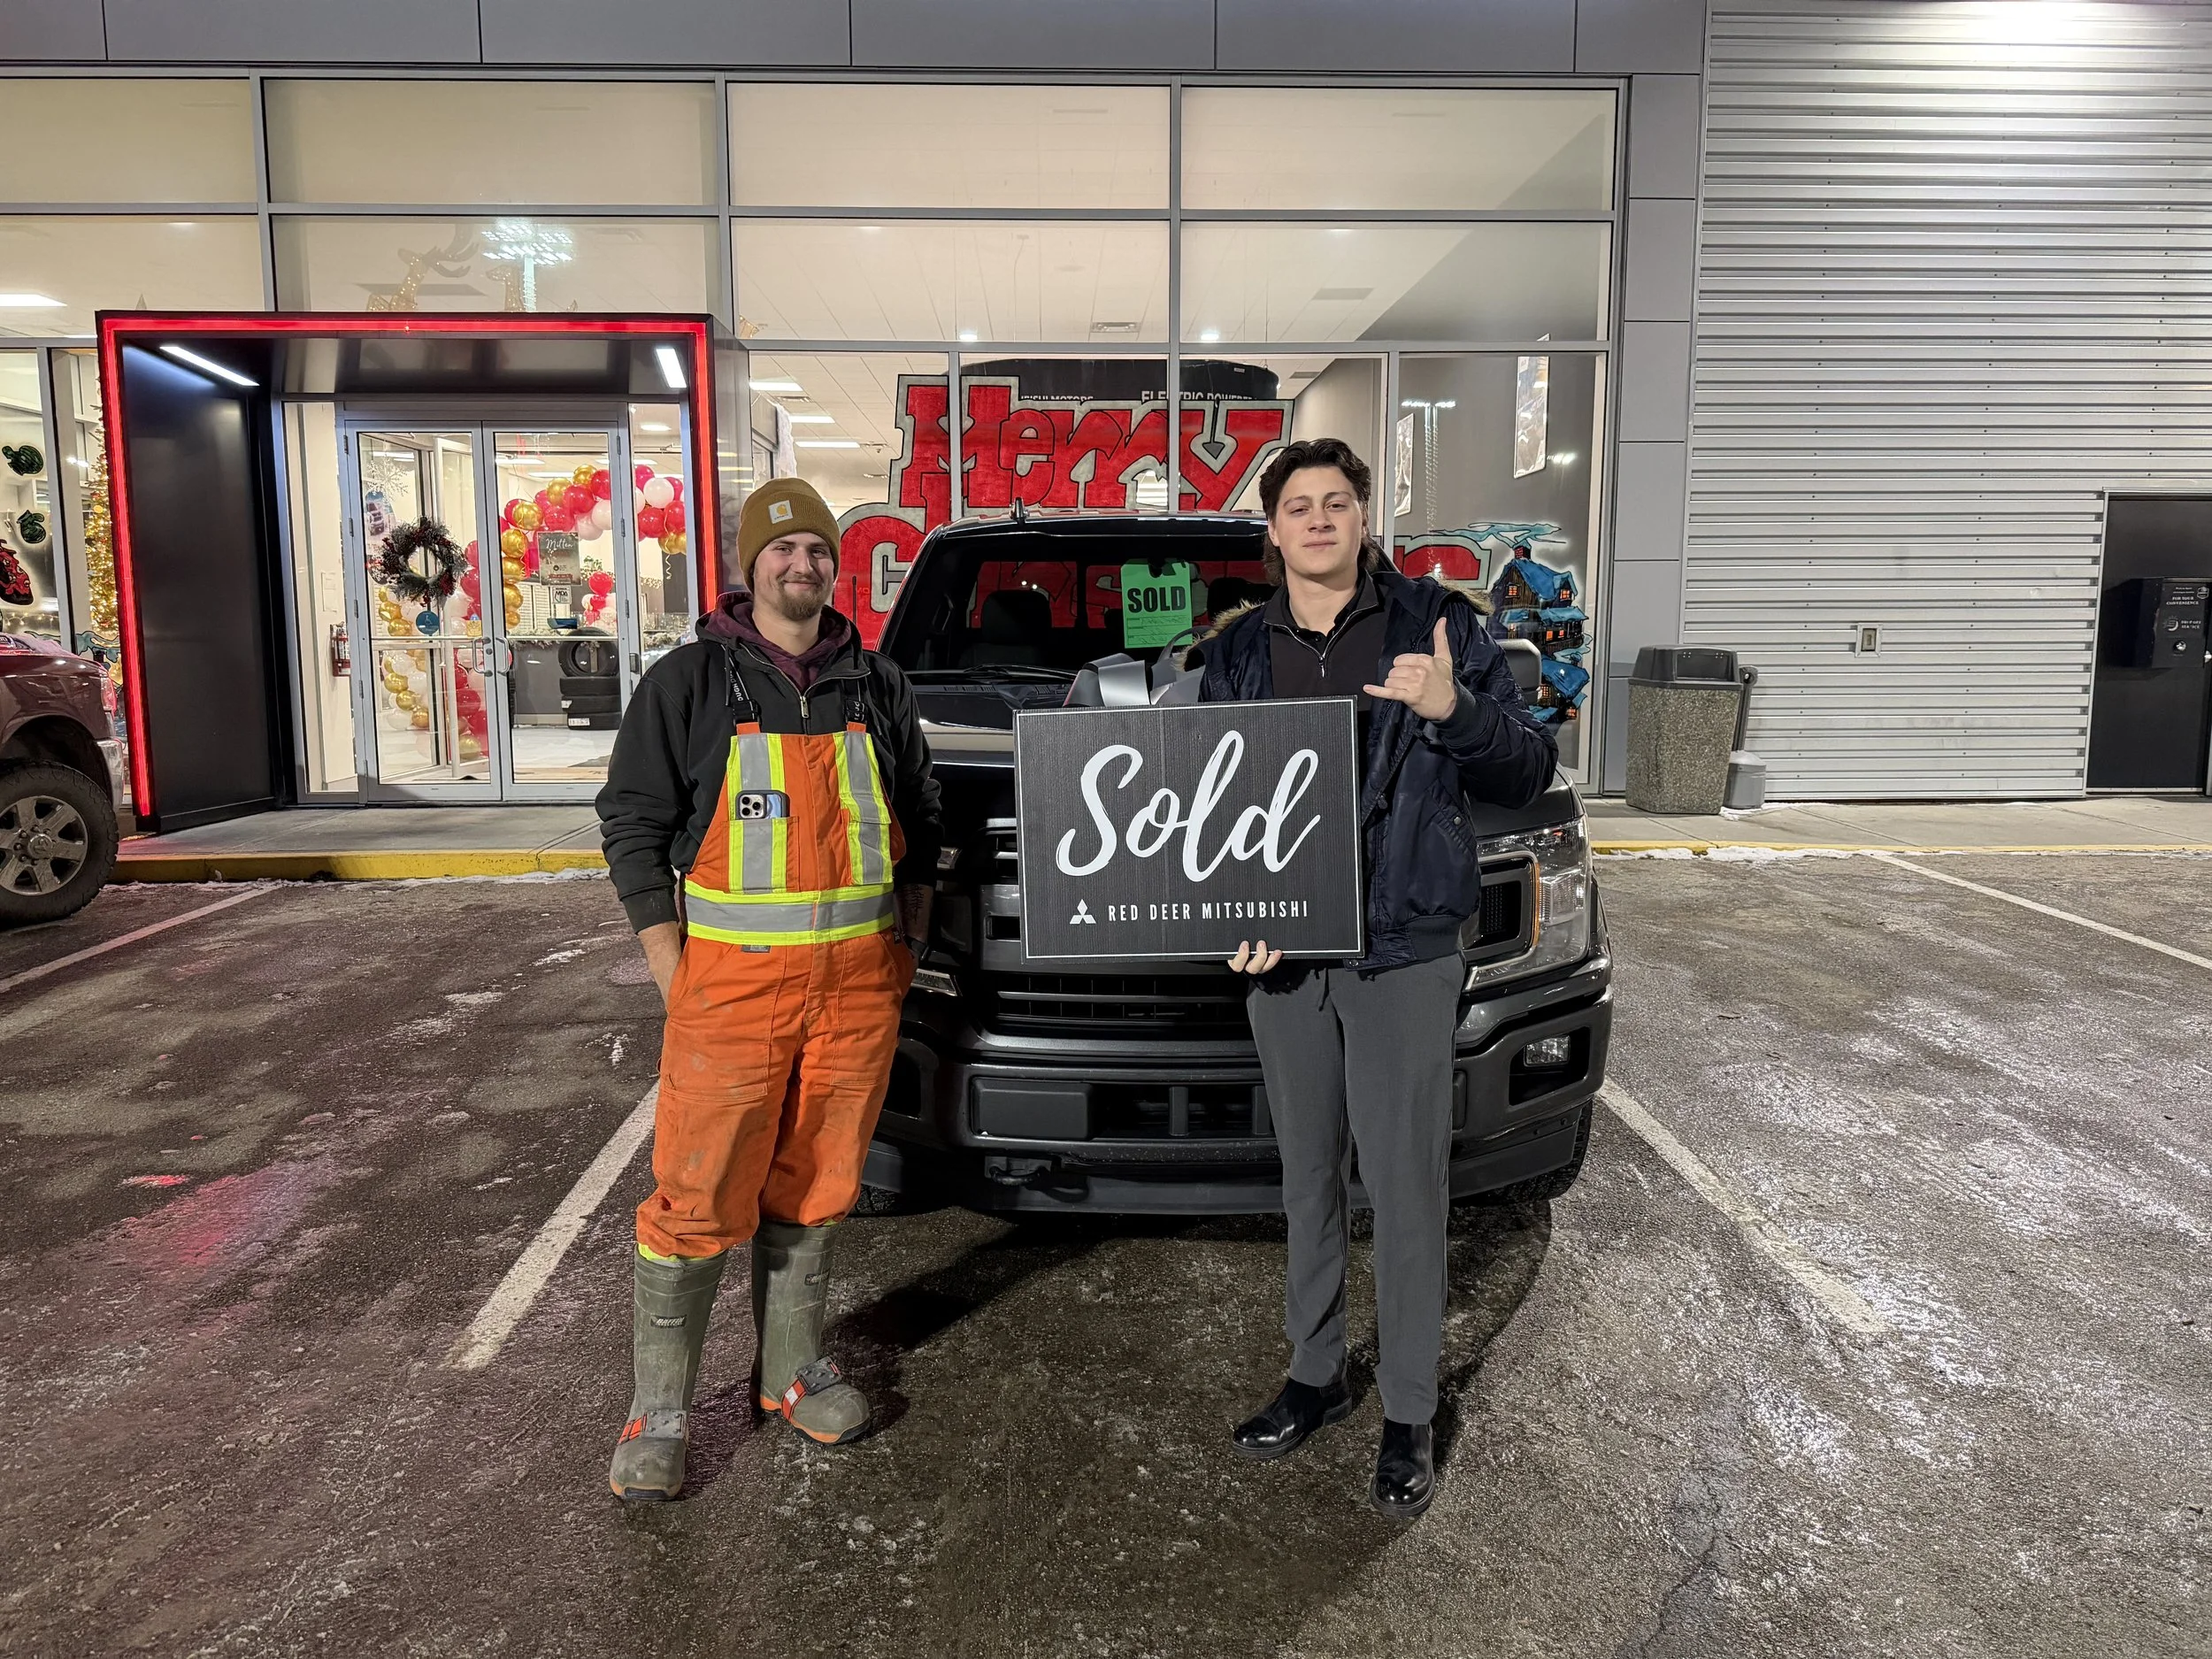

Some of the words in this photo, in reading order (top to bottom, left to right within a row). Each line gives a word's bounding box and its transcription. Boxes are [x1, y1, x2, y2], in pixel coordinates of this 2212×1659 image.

[888, 375, 1294, 511] Merry
[545, 538, 573, 549] Mitten
[1127, 586, 1187, 613] SOLD
[1056, 730, 1320, 882] Sold
[1108, 904, 1139, 922] RED
[1149, 902, 1191, 921] DEER
[1202, 900, 1308, 919] MITSUBISHI
